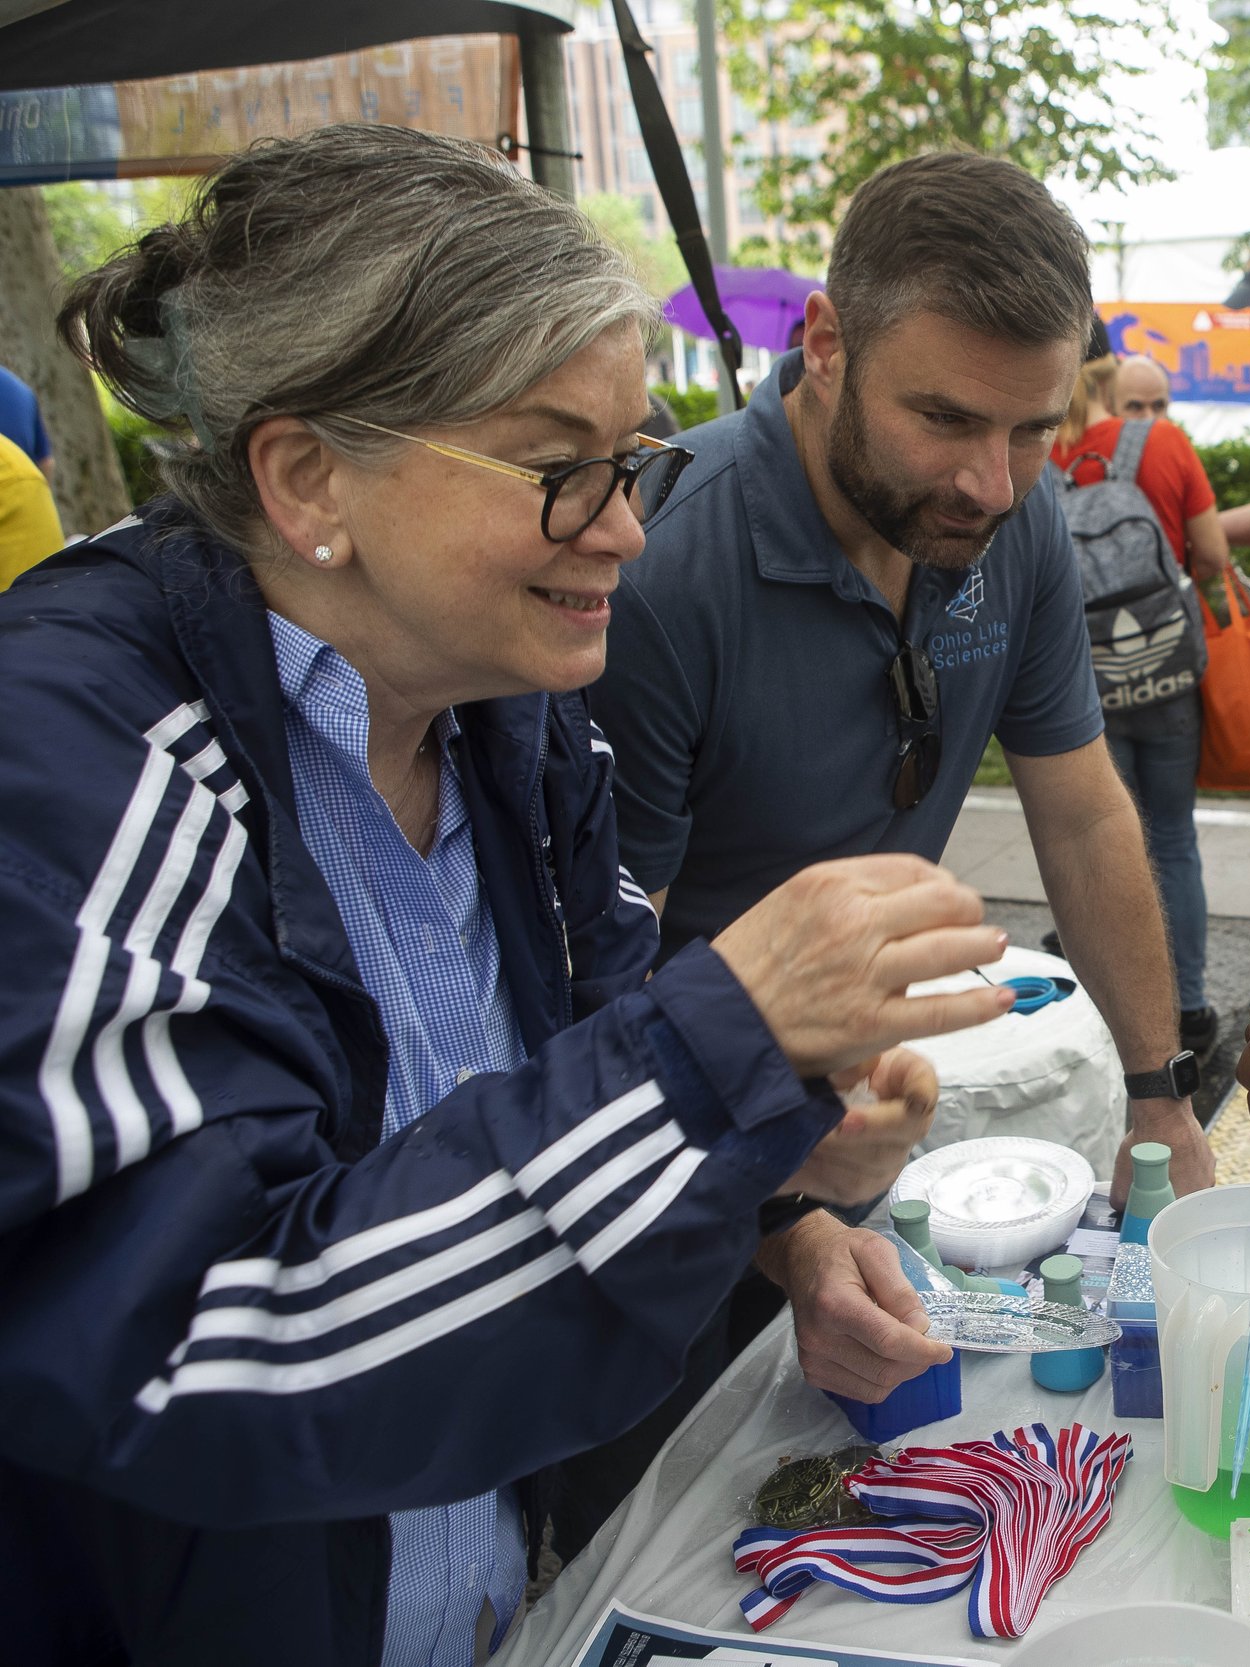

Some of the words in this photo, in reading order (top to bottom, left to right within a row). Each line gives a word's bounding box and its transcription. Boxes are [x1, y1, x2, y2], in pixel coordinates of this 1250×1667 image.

[931, 631, 972, 651] Ohio
[979, 620, 1008, 640] Life
[934, 639, 1008, 669] Sciences
[1102, 669, 1195, 710] didas
